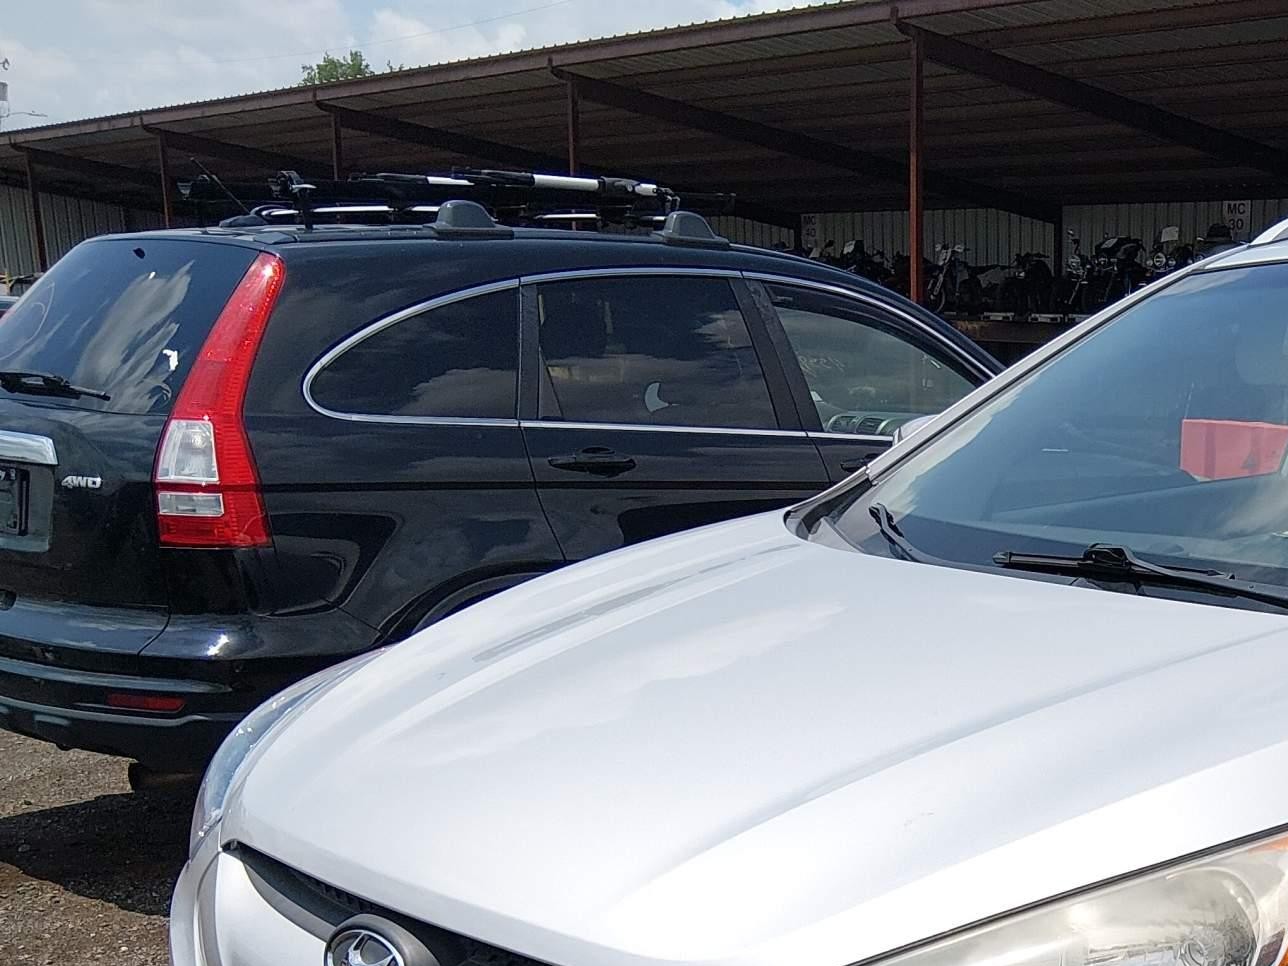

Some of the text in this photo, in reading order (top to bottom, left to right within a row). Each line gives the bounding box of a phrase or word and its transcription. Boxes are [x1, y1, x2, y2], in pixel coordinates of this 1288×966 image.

[1227, 203, 1246, 215] MC
[803, 216, 816, 225] MC
[1228, 218, 1244, 231] 30
[61, 475, 102, 489] 4WD
